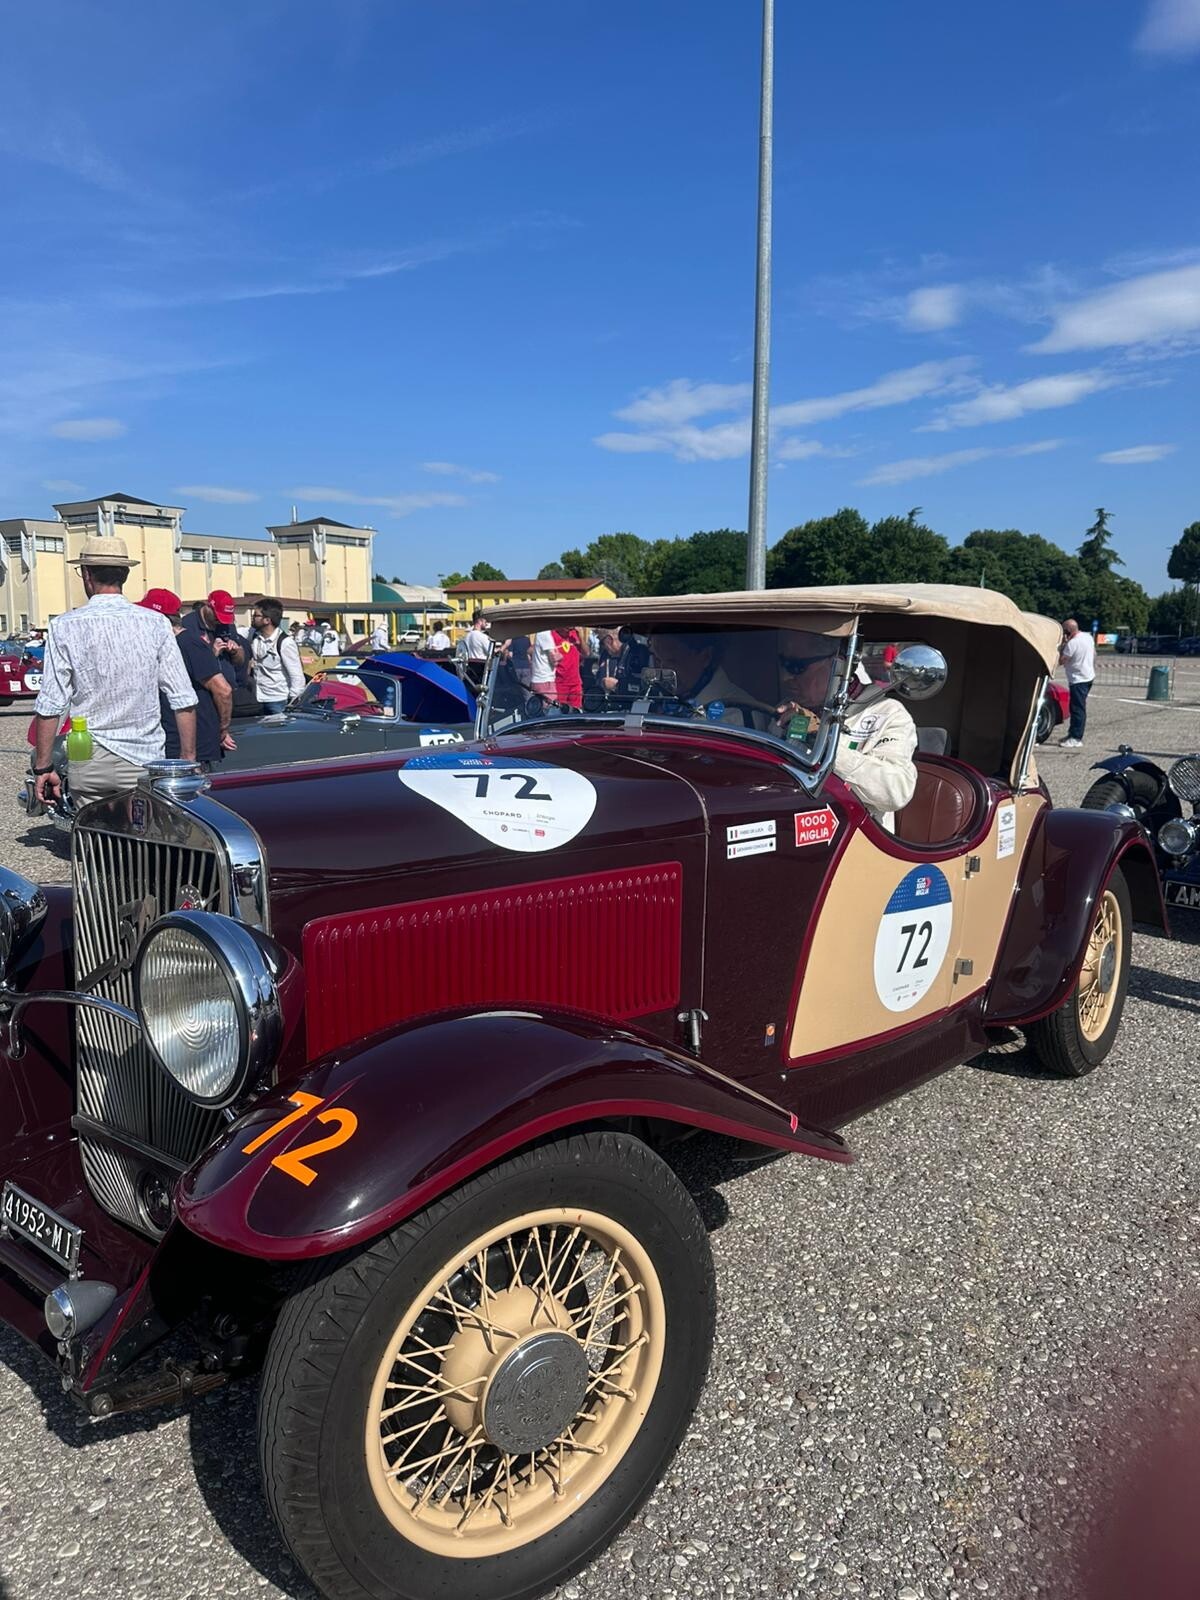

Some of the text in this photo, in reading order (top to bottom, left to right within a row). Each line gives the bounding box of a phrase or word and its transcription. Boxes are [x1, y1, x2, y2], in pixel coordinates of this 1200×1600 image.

[453, 773, 553, 801] 72
[800, 827, 829, 842] MIGLIA
[801, 814, 827, 828] 1000
[896, 920, 933, 974] 72
[241, 1090, 358, 1187] 72
